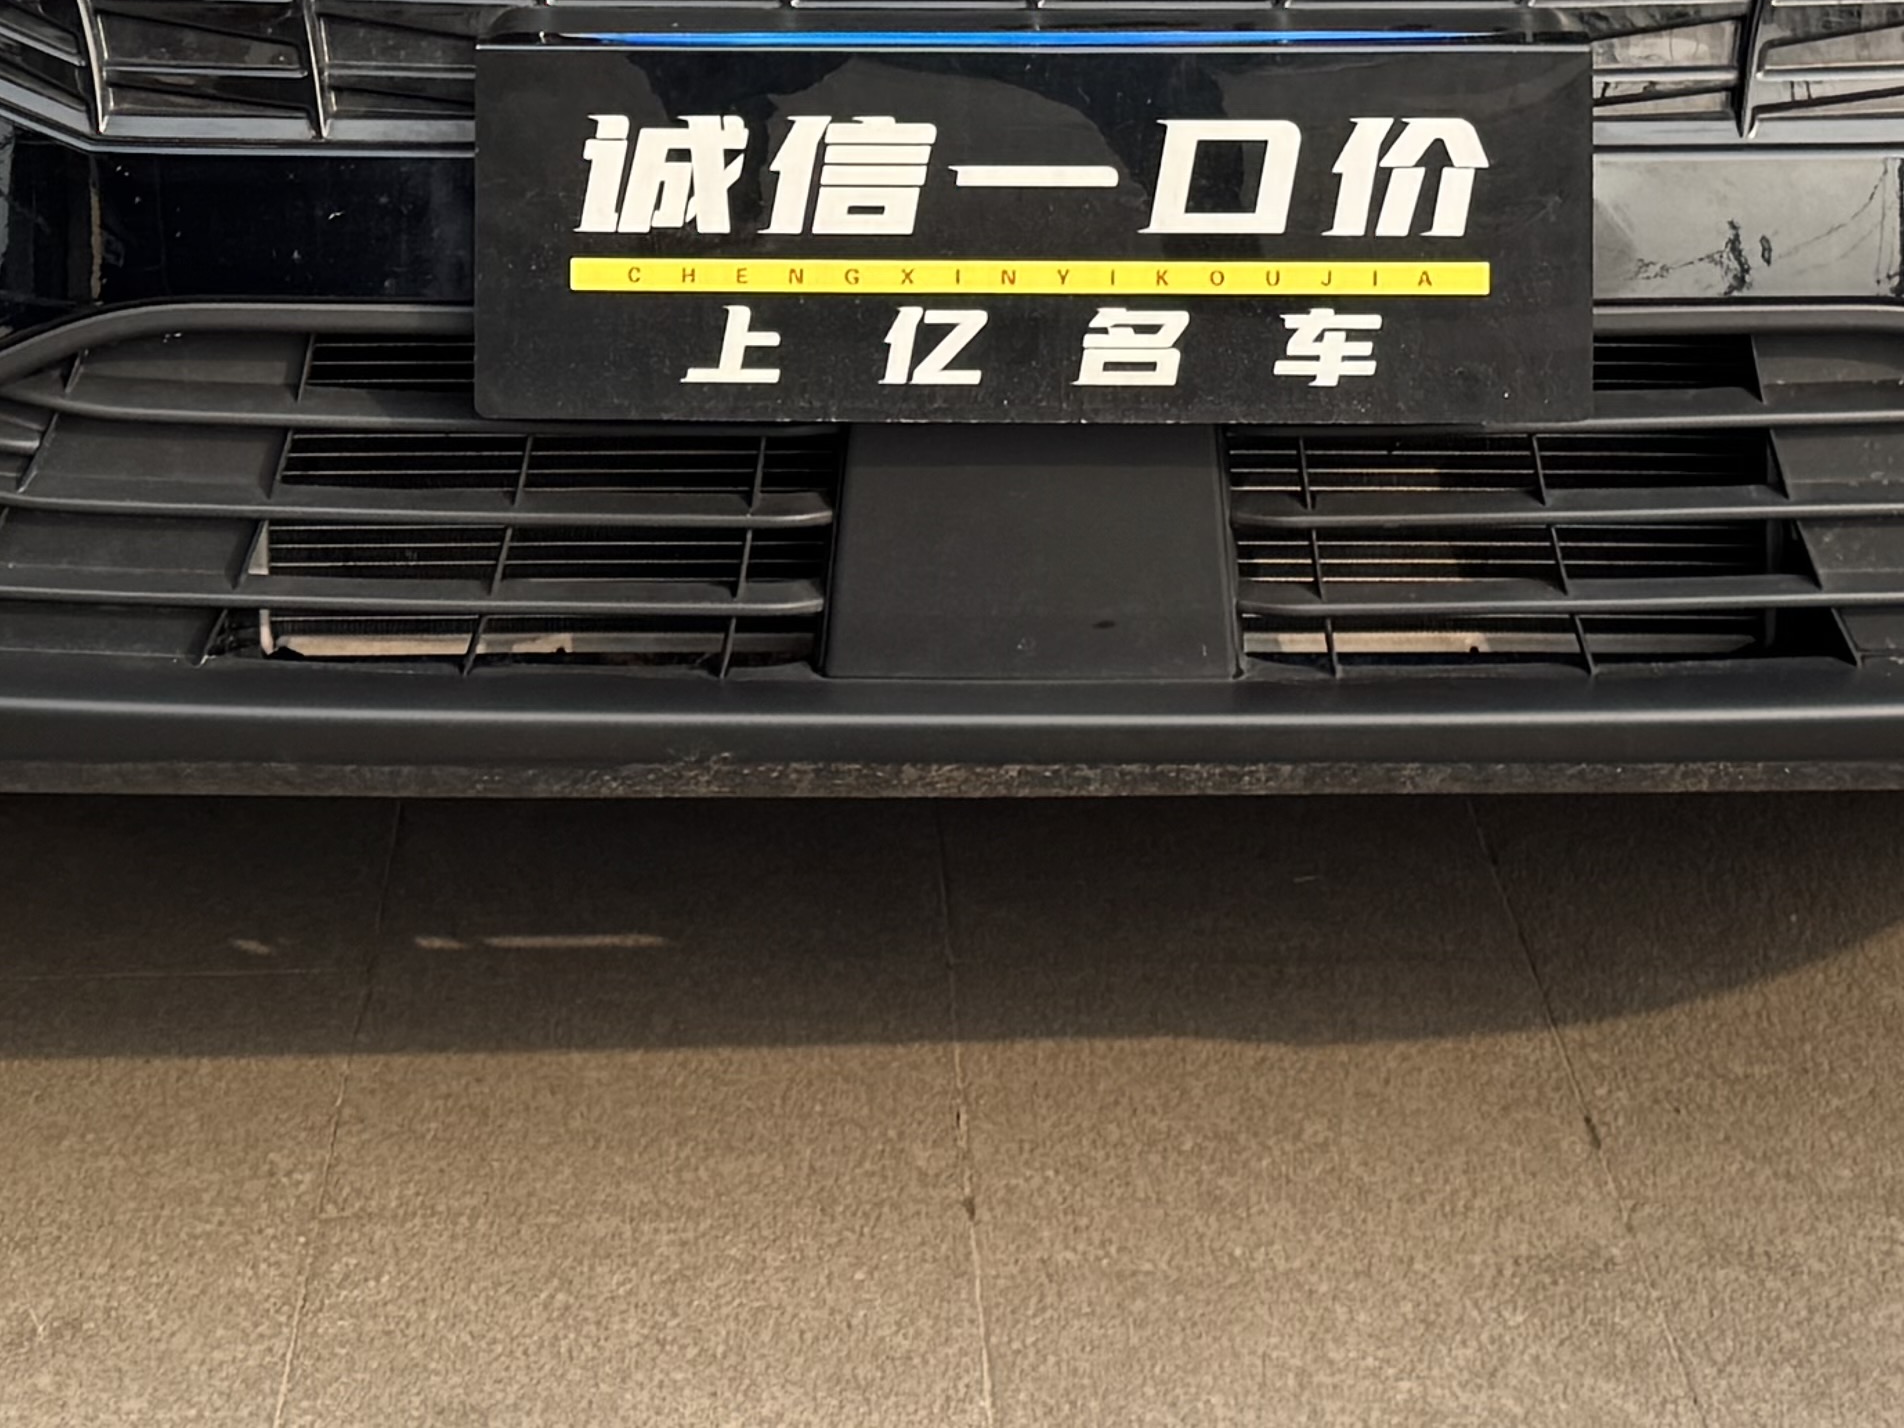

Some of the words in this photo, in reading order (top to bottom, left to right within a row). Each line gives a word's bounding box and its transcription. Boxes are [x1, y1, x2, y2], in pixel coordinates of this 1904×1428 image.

[574, 114, 1490, 237] 诚信一口价
[627, 266, 1433, 287] CHENGXINYIKOUJIA
[680, 304, 1383, 387] 上亿名车
